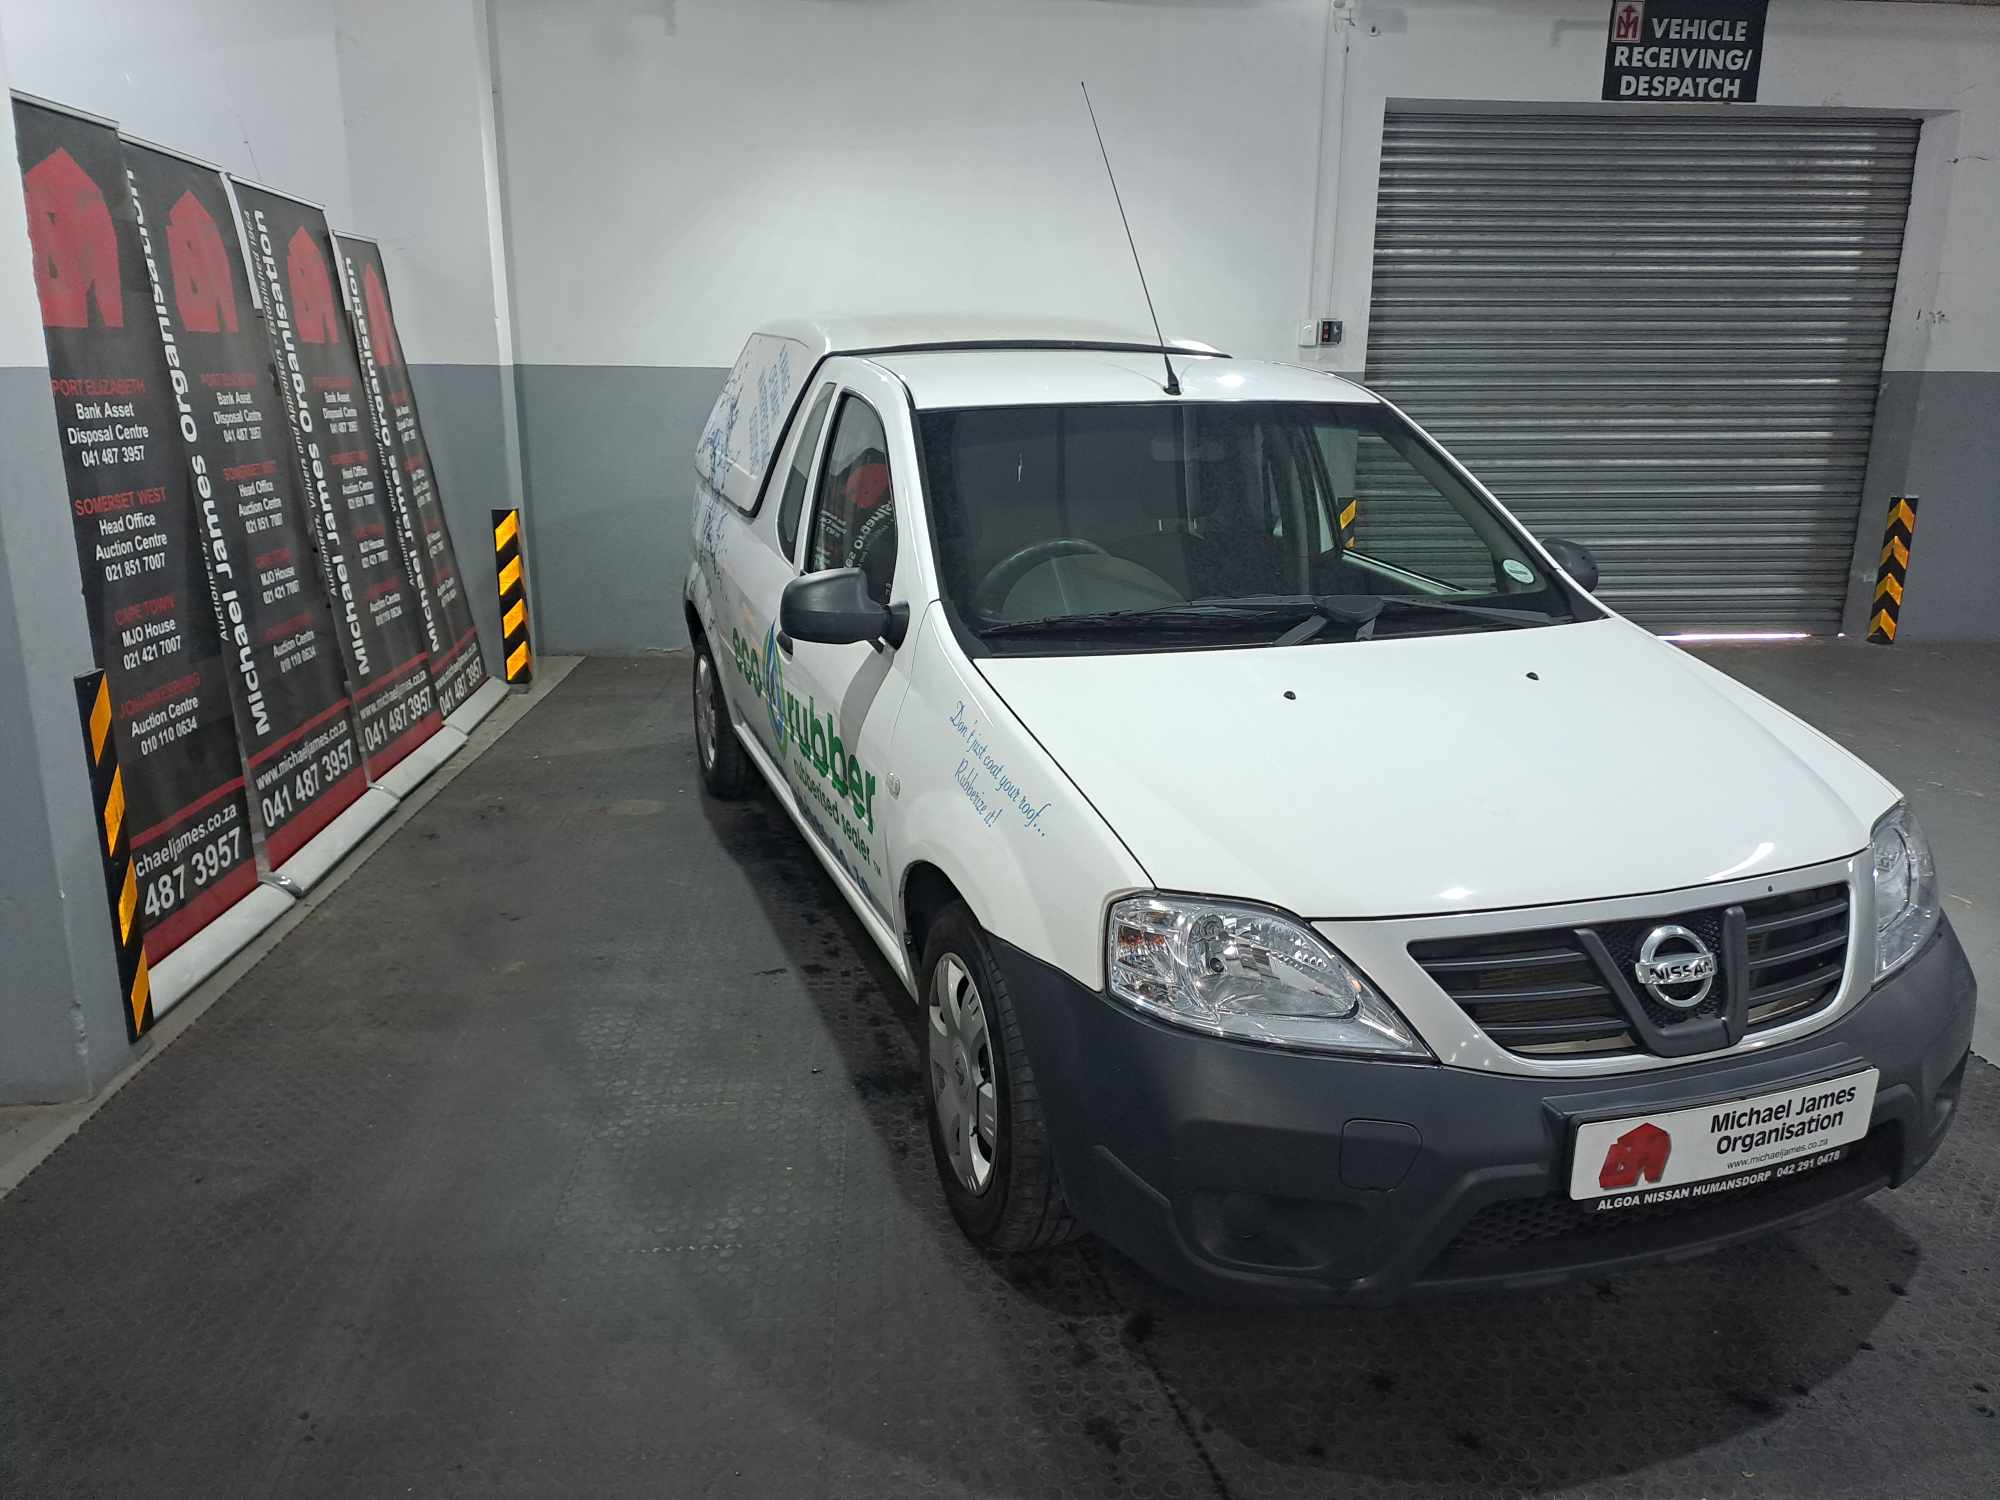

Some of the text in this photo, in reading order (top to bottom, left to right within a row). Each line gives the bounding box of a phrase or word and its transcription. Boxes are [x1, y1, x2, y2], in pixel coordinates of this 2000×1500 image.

[1651, 18, 1748, 42] VEHICLE
[1614, 46, 1752, 71] RECEIVING/
[1619, 75, 1741, 99] DESPATCH
[253, 209, 313, 433] Organisation
[345, 257, 391, 446] Organisation
[67, 423, 150, 447] Disposal Centre
[75, 401, 135, 420] Bank Asset
[81, 444, 145, 468] 041 487 3957
[191, 455, 233, 580] James
[308, 443, 340, 546] James
[389, 455, 414, 542] James
[95, 532, 168, 561] Auction Centre
[98, 512, 157, 536] Head Office
[105, 552, 166, 582] 021 851 7007
[332, 555, 370, 676] Michael
[409, 549, 439, 653] Michael
[121, 618, 177, 647] MJO House
[123, 635, 182, 670] 021 421 7007
[222, 590, 271, 738] Michael
[439, 655, 483, 716] 041 487 3957
[131, 696, 199, 738] Auction Centre
[141, 715, 198, 756] 010 110 0634
[364, 686, 432, 751] 041 487 3957
[262, 739, 353, 828] 041 487 3957
[786, 695, 876, 835] rubber
[954, 757, 988, 816] Rubberize
[965, 732, 988, 760] just
[983, 755, 1005, 780] coat
[995, 775, 1021, 802] your
[135, 803, 238, 877] chaeljames.co.za
[841, 814, 870, 866] sealer
[144, 826, 241, 917] 487 3957
[1650, 960, 1713, 983] NISSAN
[1710, 1086, 1857, 1133] Michael James
[1716, 1110, 1844, 1155] Organisation
[1726, 1138, 1829, 1170] www.michaeljames.co.za
[1597, 1150, 1841, 1211] ALGOA NISSAN HUMANSDORP 042 291 0478
